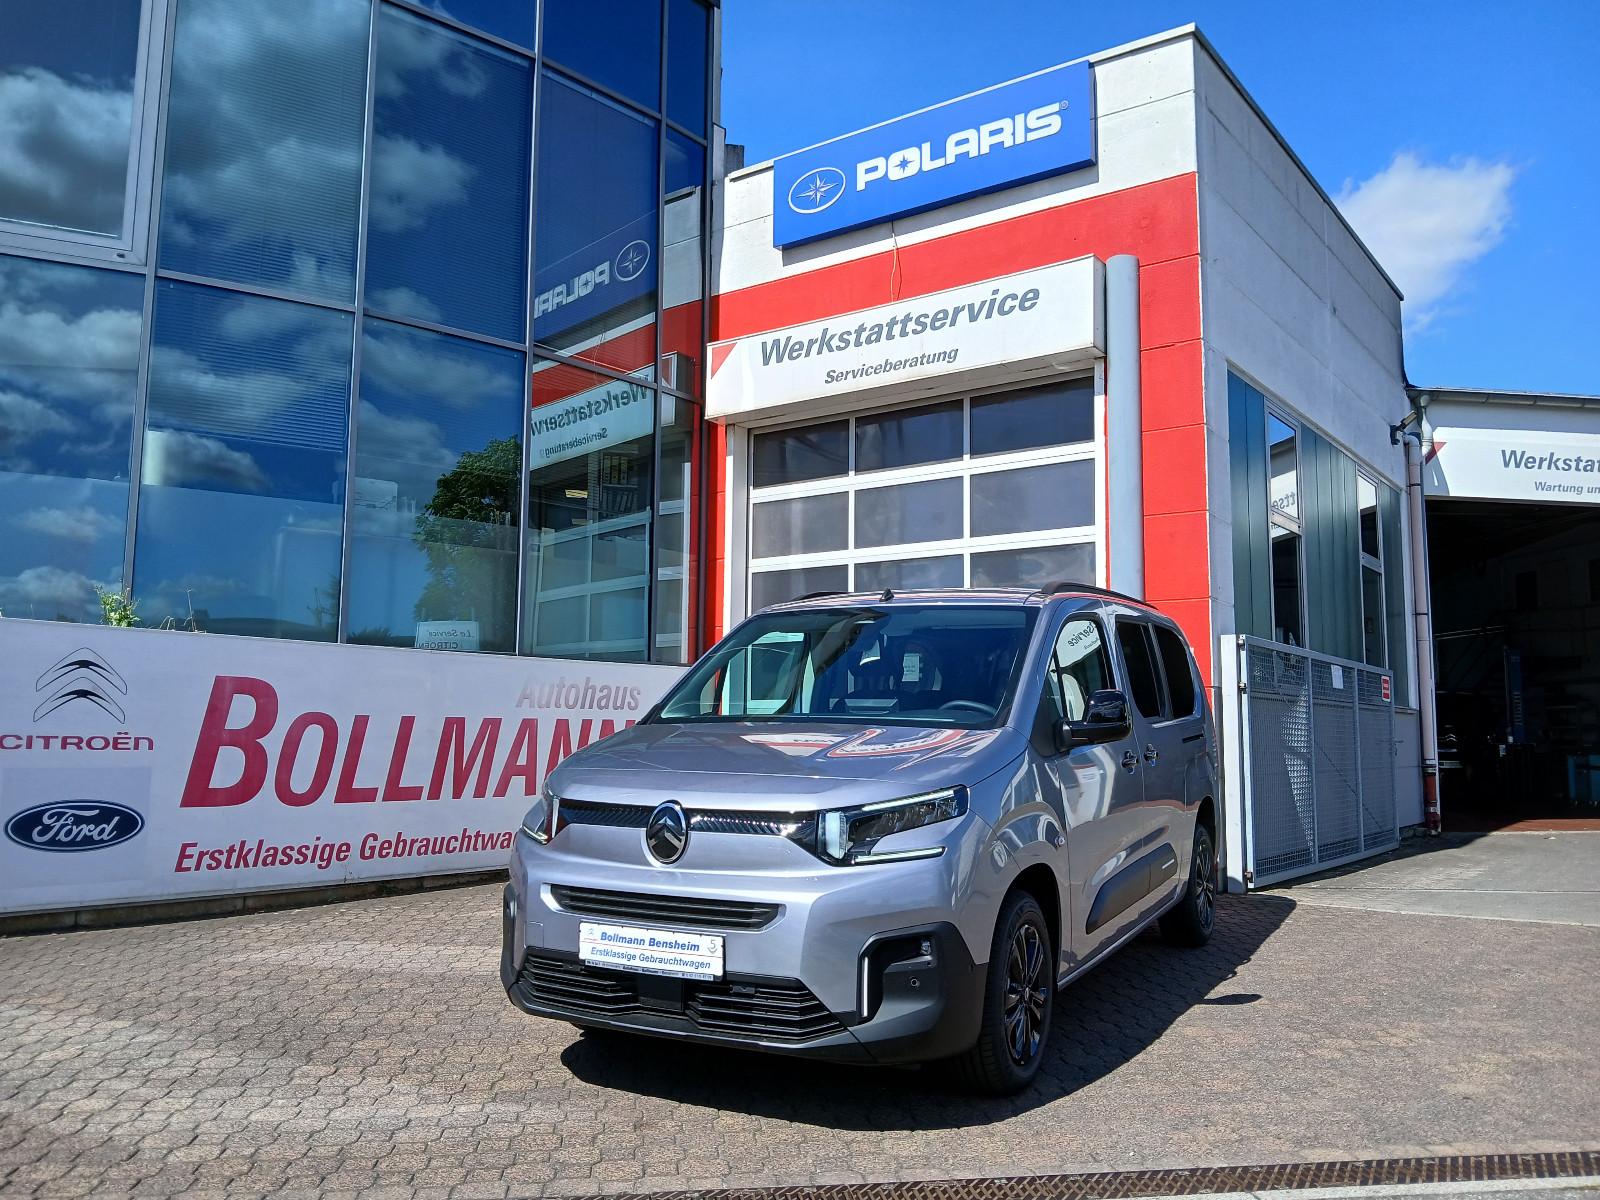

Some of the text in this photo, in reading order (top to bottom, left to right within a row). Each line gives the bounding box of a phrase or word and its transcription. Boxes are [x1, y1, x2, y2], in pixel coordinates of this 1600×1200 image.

[856, 102, 1062, 192] POLARIS
[761, 287, 1040, 366] Werkstattservice
[824, 347, 959, 385] Serviceberatung
[1535, 481, 1583, 495] Wartung
[515, 677, 642, 711] Autohaus
[0, 732, 154, 751] CITROËN
[180, 675, 637, 808] BOLLMAN
[32, 808, 120, 843] Ford
[174, 828, 516, 873] Erstklassige Gebrauchtwa
[591, 947, 637, 961] Erstklassige
[638, 953, 711, 969] Gebrauchtwagen
[600, 931, 700, 952] Bollmann Bensheim
